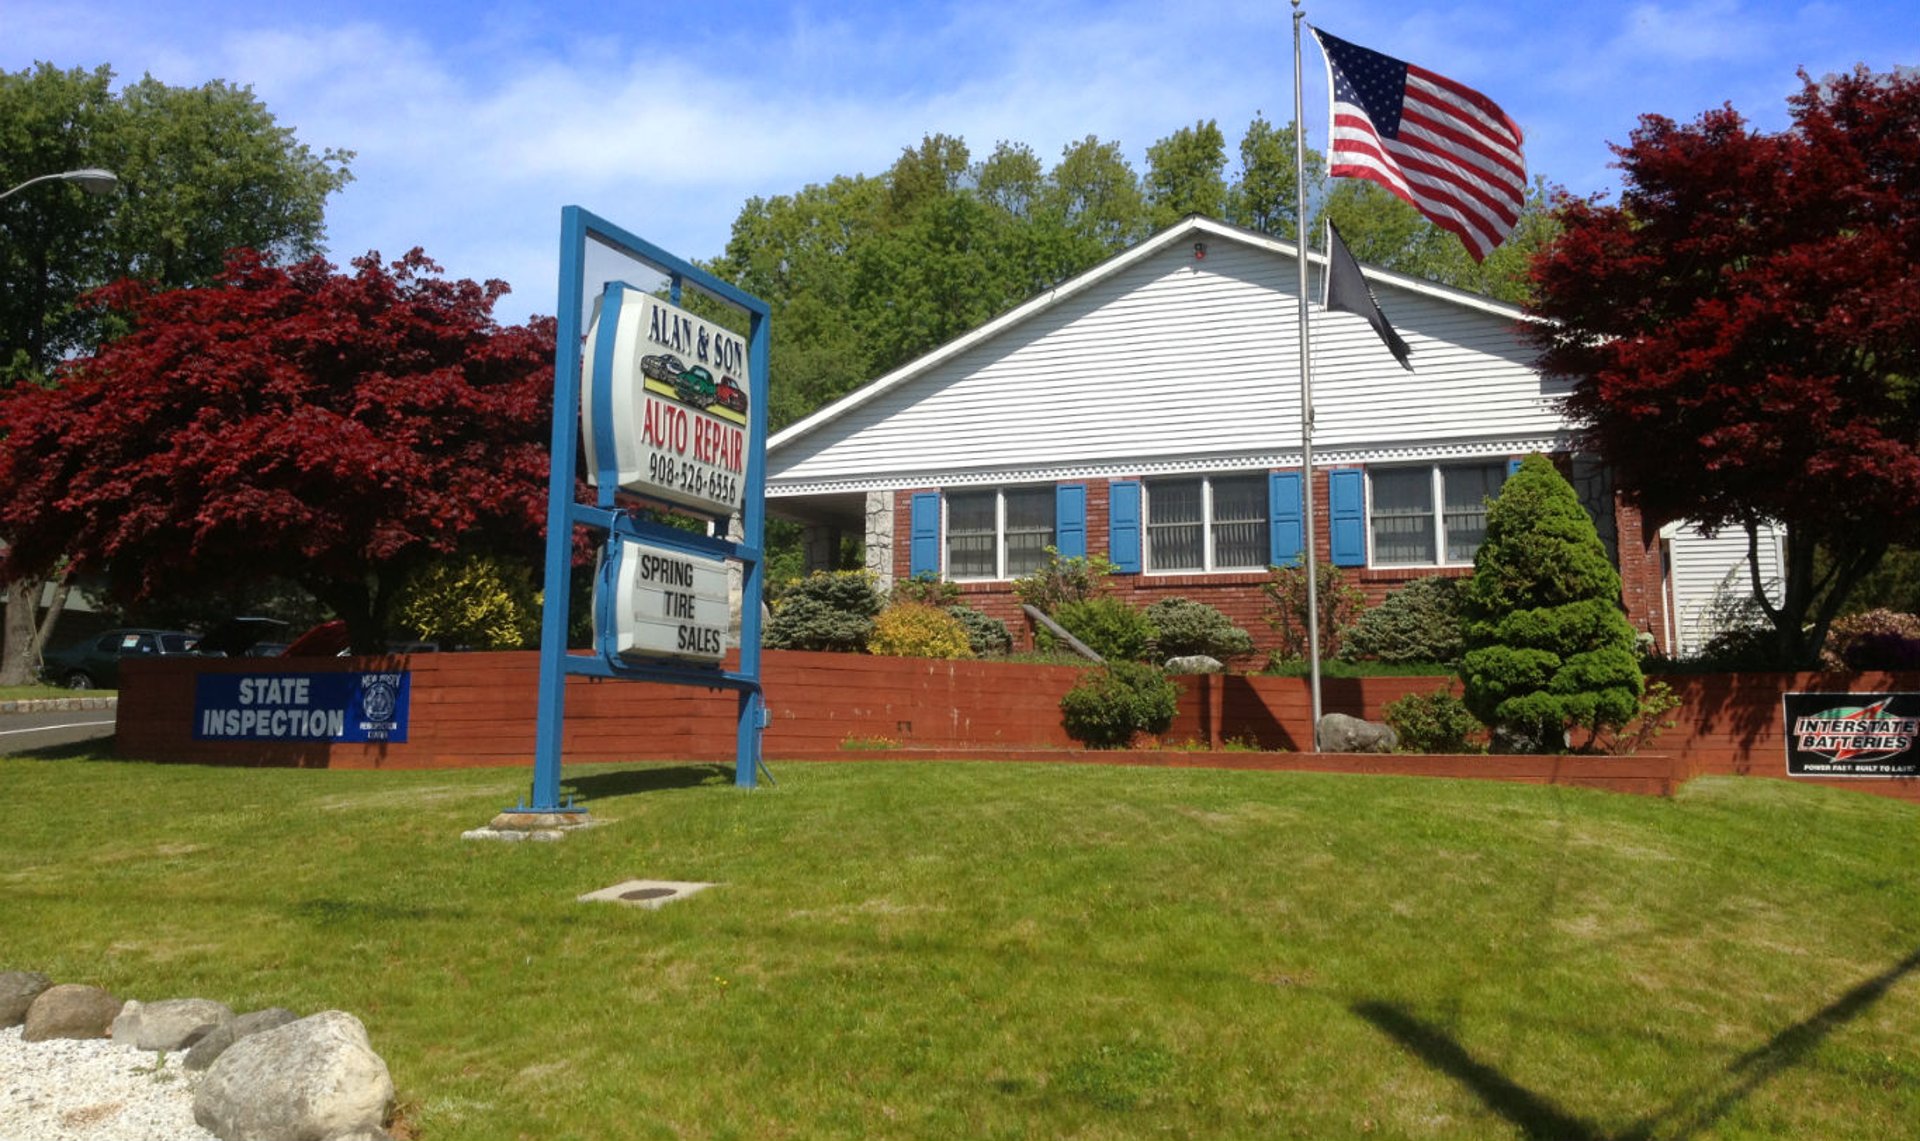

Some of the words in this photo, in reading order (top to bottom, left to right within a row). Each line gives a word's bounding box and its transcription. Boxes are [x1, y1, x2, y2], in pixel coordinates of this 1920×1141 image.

[649, 304, 692, 356] ALAN
[697, 325, 709, 361] &
[714, 333, 743, 376] SON
[641, 398, 688, 453] AUTO
[693, 415, 743, 473] REPAIR
[650, 452, 736, 503] 908-526-6556
[641, 554, 694, 588] SPRING
[664, 590, 695, 620] TIRE
[678, 625, 720, 654] SALES
[238, 678, 310, 705] STATE
[202, 709, 344, 737] INSPECTION
[1799, 720, 1915, 733] INTERSTATE
[1803, 735, 1908, 749] BATTERIES
[1804, 764, 1831, 772] POWER
[1855, 764, 1877, 772] BUILT
[1880, 764, 1890, 772] TO
